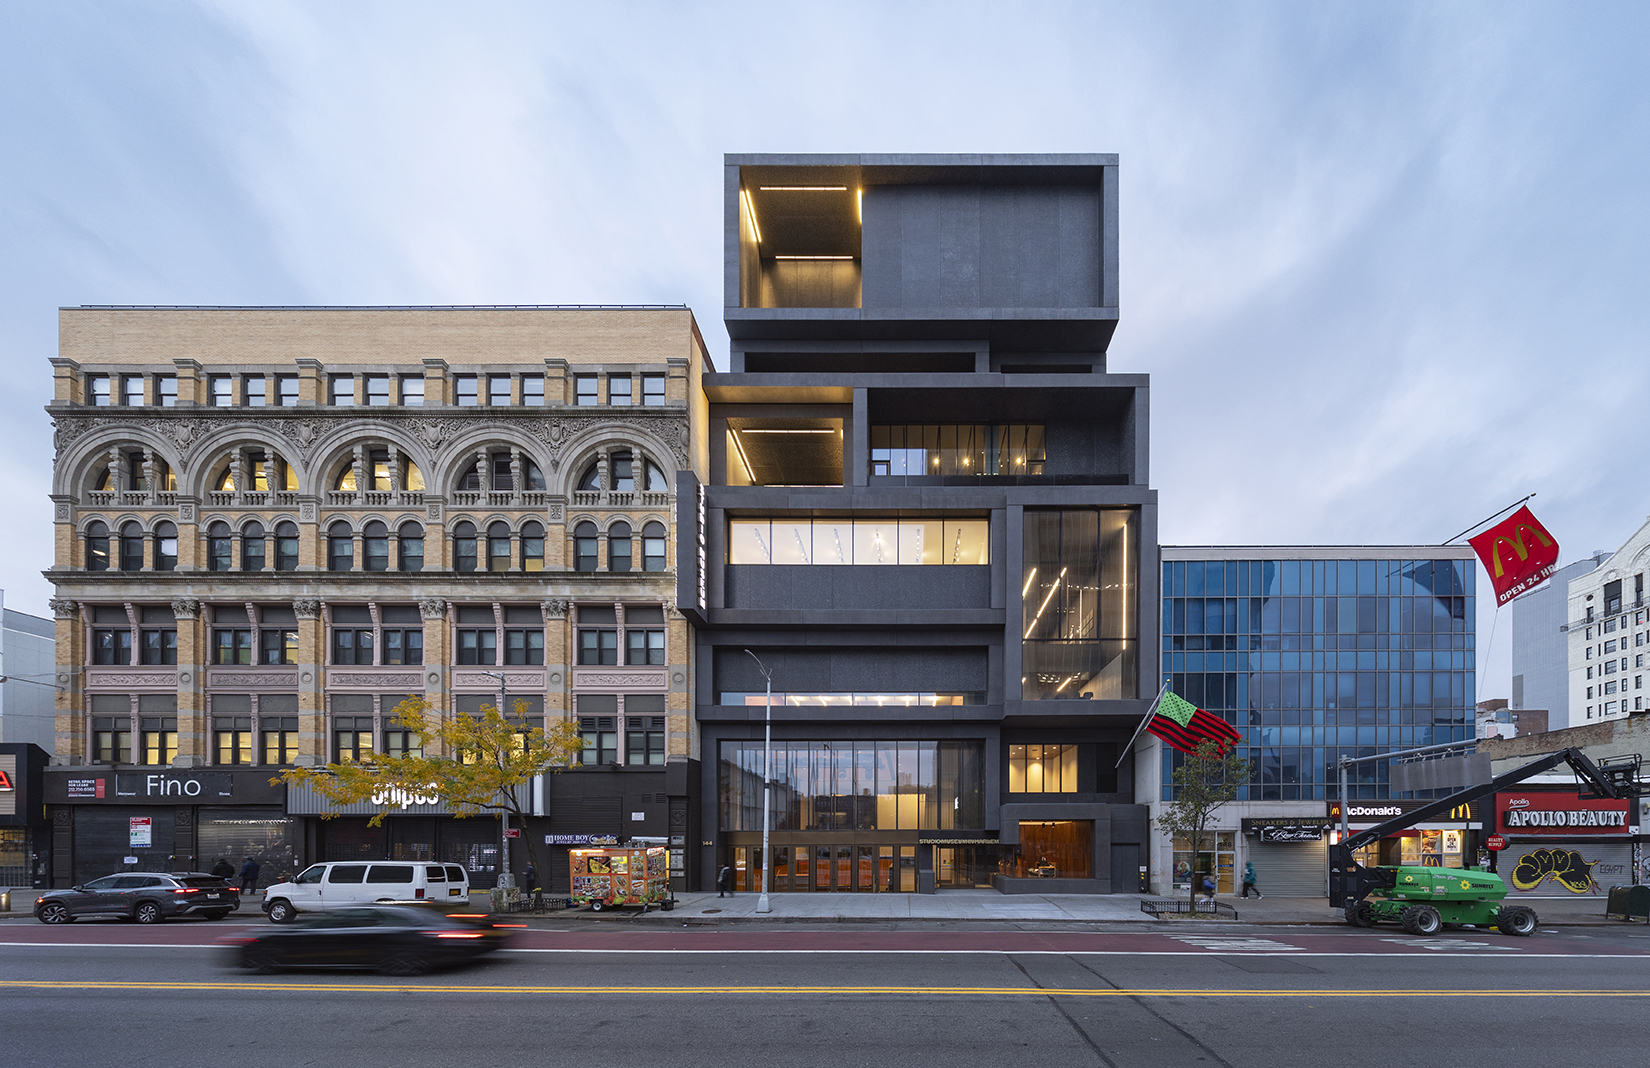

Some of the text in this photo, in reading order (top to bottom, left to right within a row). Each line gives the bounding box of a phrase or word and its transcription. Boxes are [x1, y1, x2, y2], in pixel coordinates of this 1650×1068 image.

[1499, 583, 1526, 602] OPEN
[1526, 574, 1540, 586] 24
[147, 774, 201, 796] Fino
[1509, 798, 1530, 806] Apollo
[1509, 810, 1627, 827] APOLLO BEAUTY
[1599, 864, 1626, 875] EGYPT
